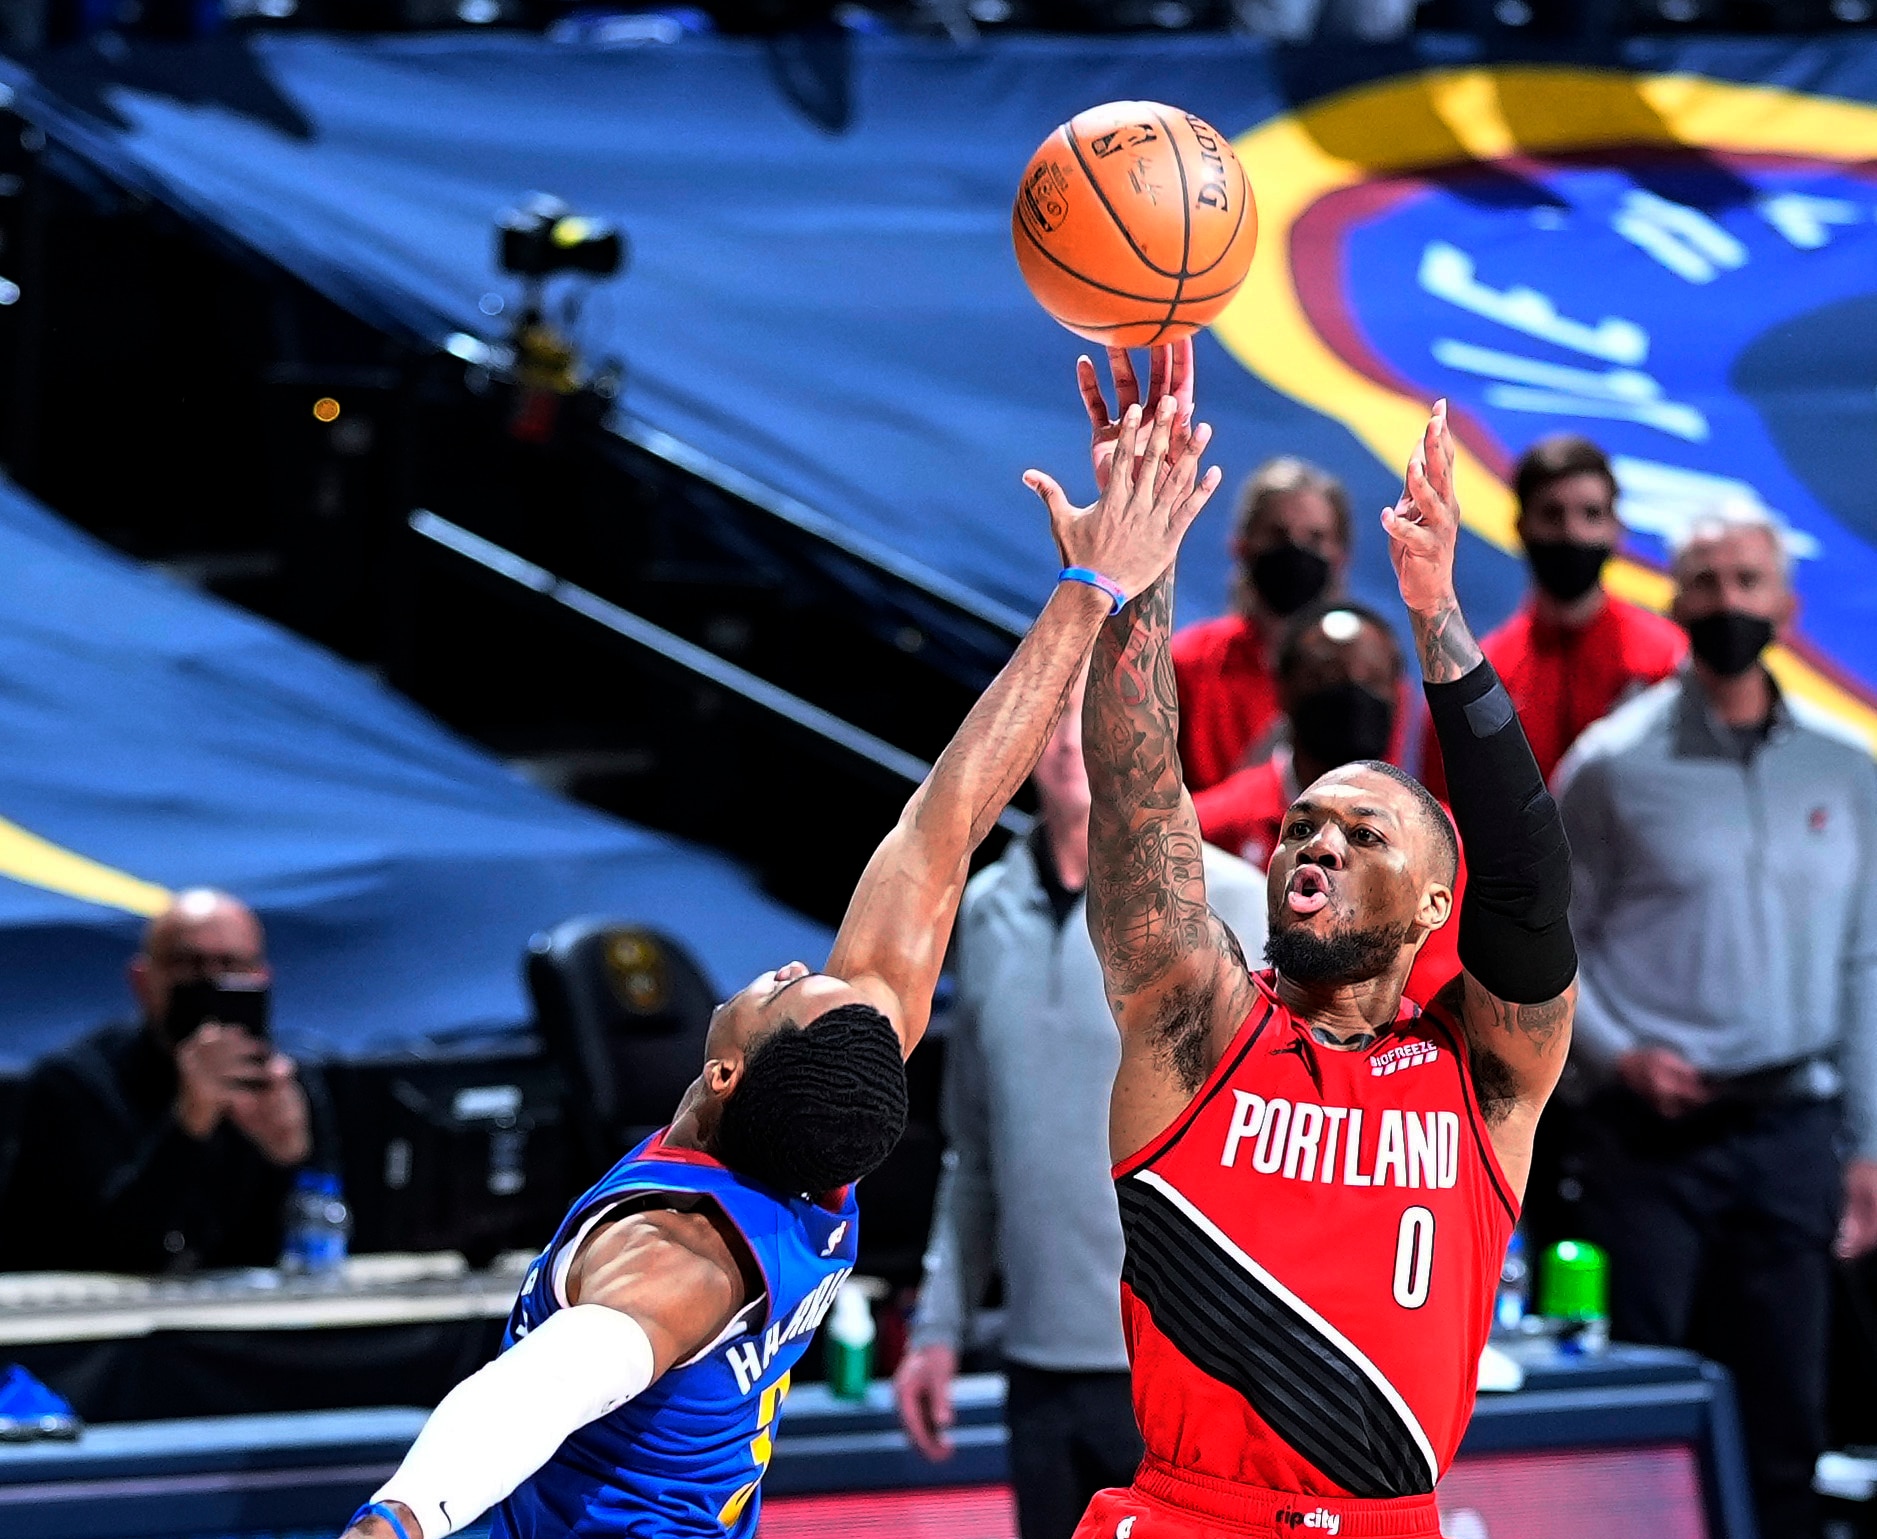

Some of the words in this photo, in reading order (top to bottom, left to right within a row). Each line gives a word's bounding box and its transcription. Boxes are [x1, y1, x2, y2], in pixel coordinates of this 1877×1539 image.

[1369, 1039, 1437, 1067] BIOFREEZE
[1220, 1089, 1460, 1189] PORTLAND
[1392, 1205, 1435, 1310] 0
[1275, 1504, 1341, 1535] ripcity
